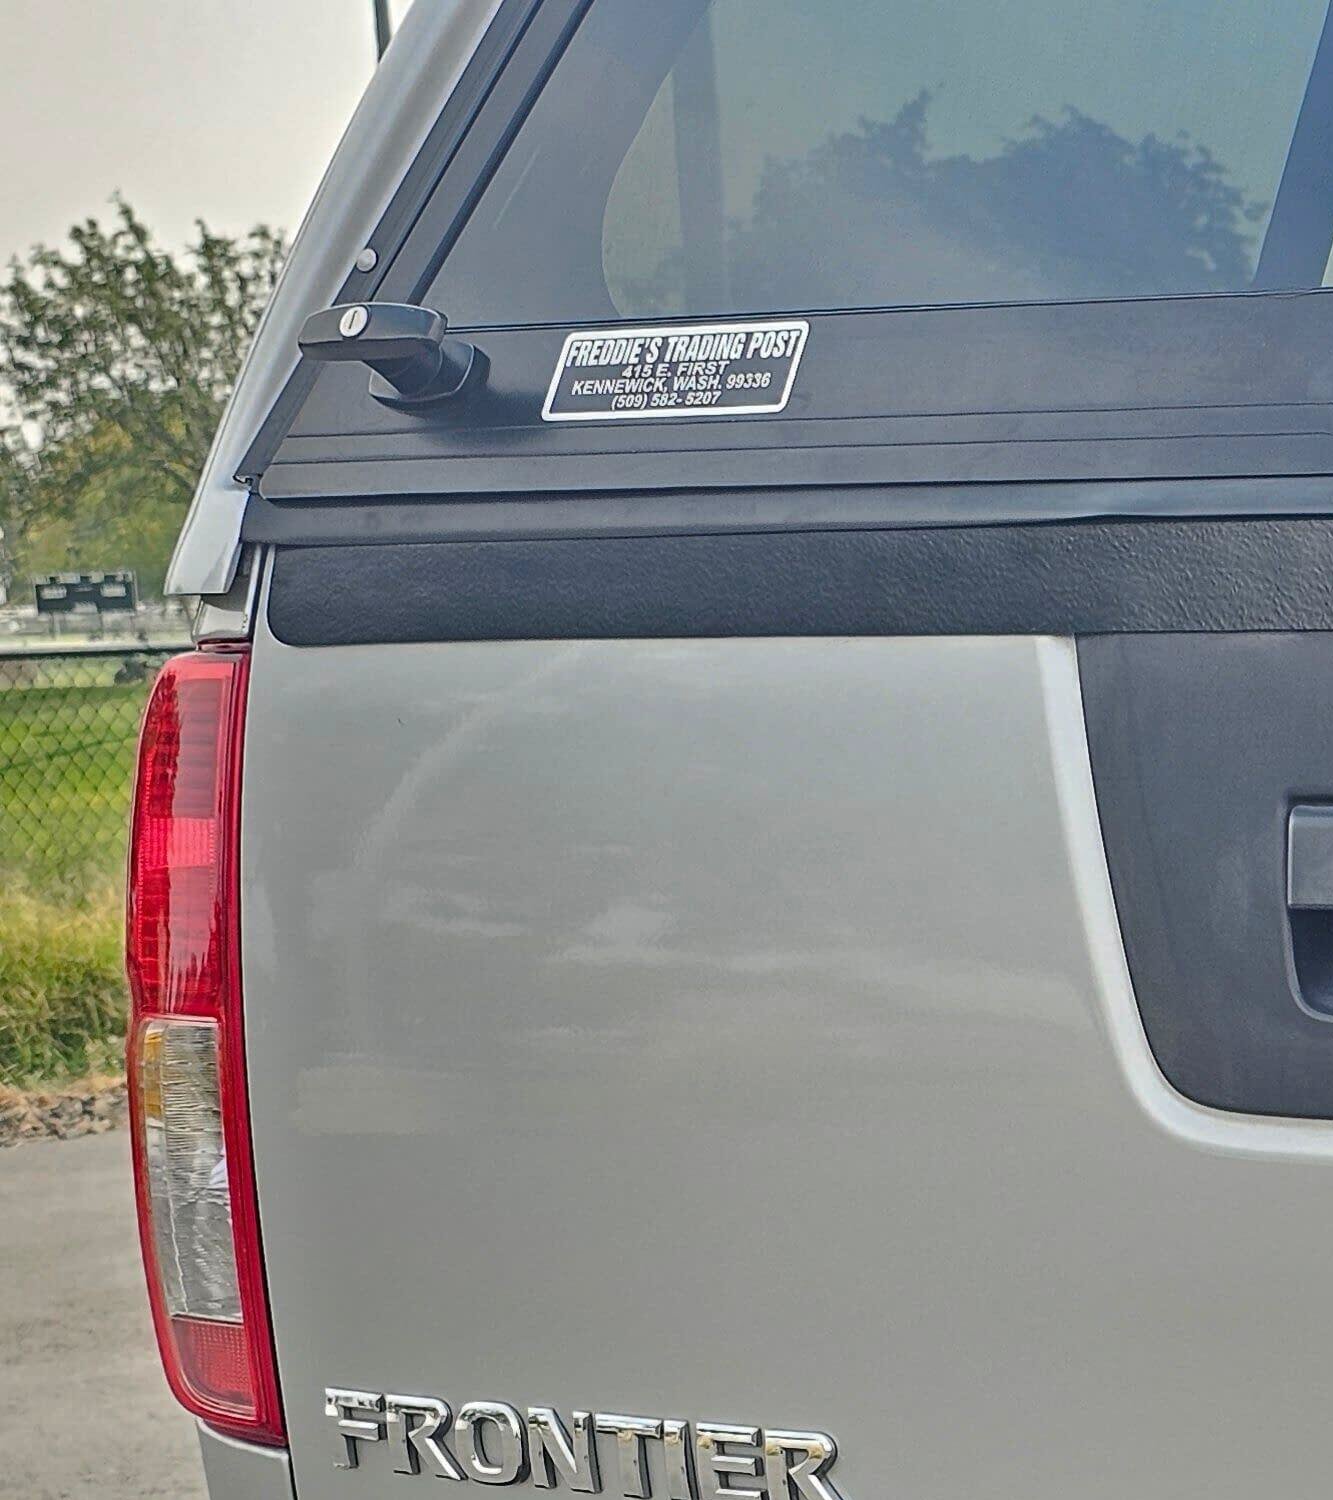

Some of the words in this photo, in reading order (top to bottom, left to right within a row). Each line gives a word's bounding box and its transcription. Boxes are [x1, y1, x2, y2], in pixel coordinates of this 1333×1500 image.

[565, 337, 662, 368] FREDDIE'S
[664, 334, 745, 363] TRADING
[746, 330, 800, 359] POST
[621, 364, 653, 378] 415
[656, 363, 672, 377] E.
[676, 360, 730, 376] FIRST
[571, 377, 668, 396] KENNEWICK,
[672, 374, 722, 391] WASH.
[725, 372, 772, 390] 99336
[610, 391, 648, 411] (509)
